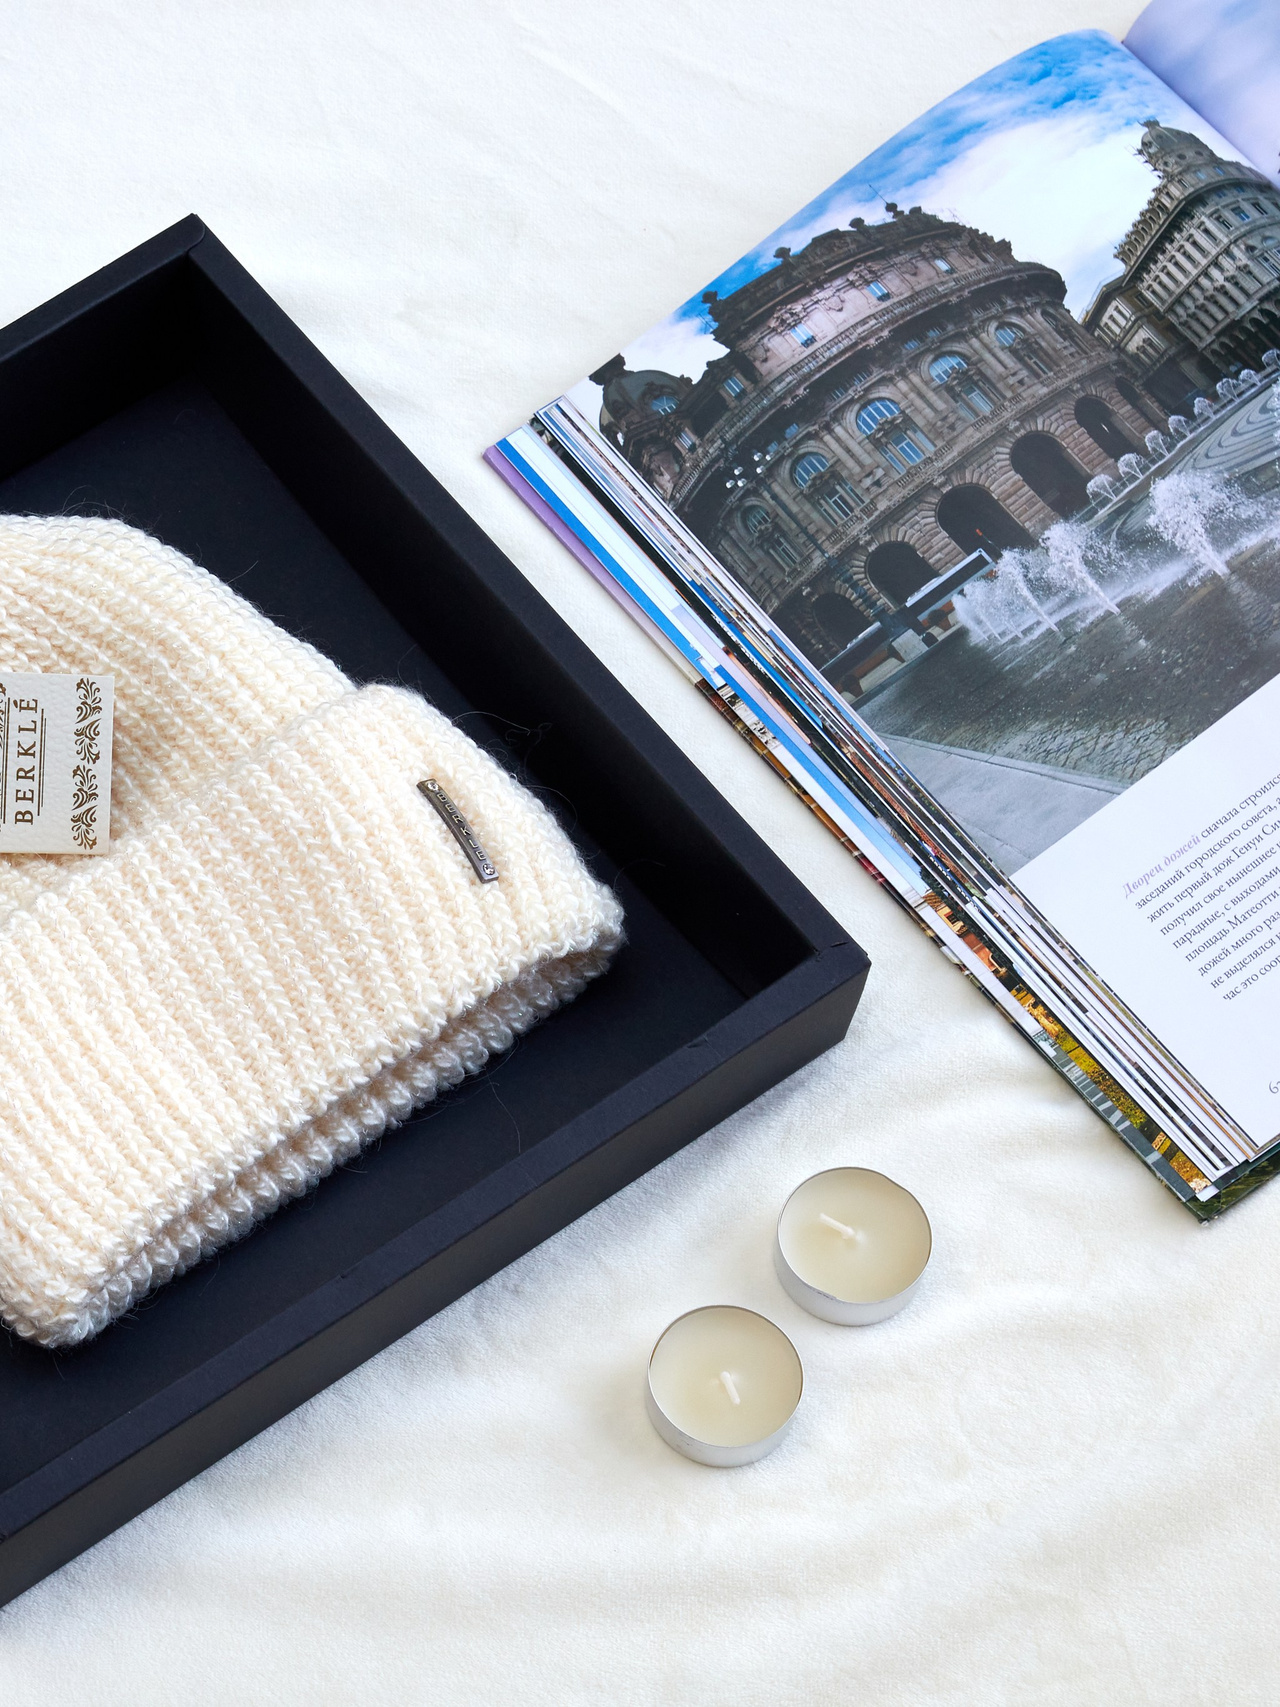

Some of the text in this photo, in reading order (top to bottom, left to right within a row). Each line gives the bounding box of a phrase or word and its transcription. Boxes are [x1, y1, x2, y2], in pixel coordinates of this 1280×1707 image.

[13, 698, 39, 826] BERKLÉ
[437, 792, 487, 861] BERKLE
[1122, 863, 1165, 899] Дворец
[1163, 834, 1201, 867] дожей
[1201, 807, 1240, 838] сначала
[1135, 868, 1186, 909] заседаний
[1184, 828, 1241, 873] городского
[1241, 803, 1278, 831] совета,
[1147, 900, 1175, 923] жить
[1174, 870, 1213, 903] первый
[1212, 855, 1236, 876] дож
[1231, 834, 1264, 859] Генуи
[1160, 846, 1277, 936] получил свое нынешнее
[1172, 866, 1280, 949] парадные, с выходами
[1185, 890, 1279, 962] площадь Матеотти
[1197, 947, 1233, 977] дожей
[1231, 924, 1264, 951] много
[1210, 938, 1276, 989] не выделялся
[1223, 985, 1242, 1001] час
[1240, 973, 1259, 990] это
